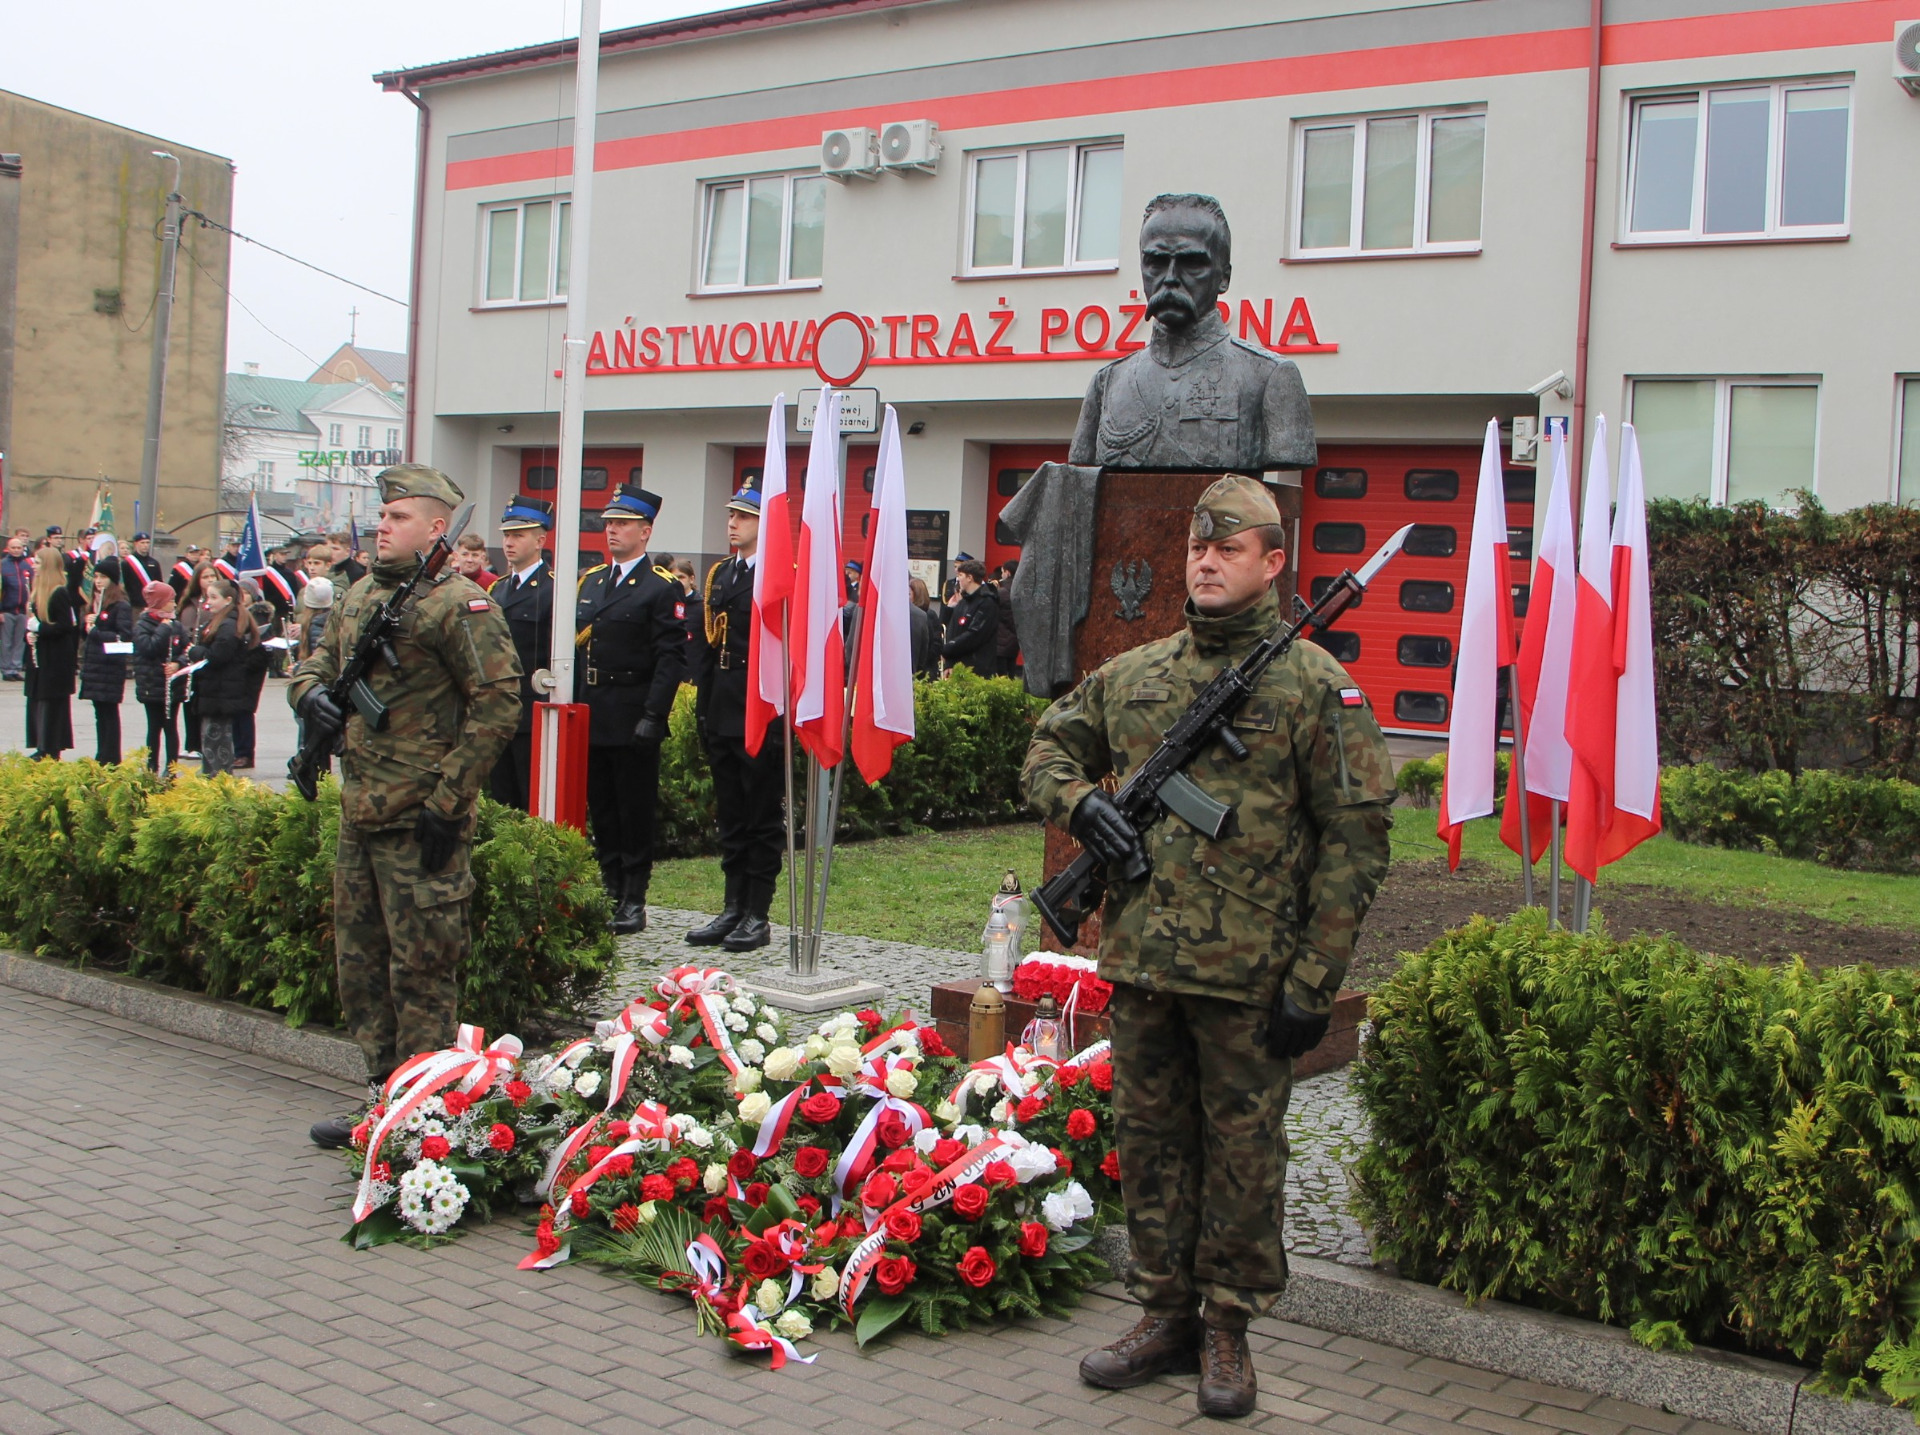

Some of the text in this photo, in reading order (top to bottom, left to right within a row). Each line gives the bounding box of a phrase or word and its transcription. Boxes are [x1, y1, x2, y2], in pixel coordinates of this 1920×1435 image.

[563, 316, 818, 369] AŃSTWOWA
[1040, 290, 1319, 353] POŻNA
[297, 450, 347, 466] SZAFY
